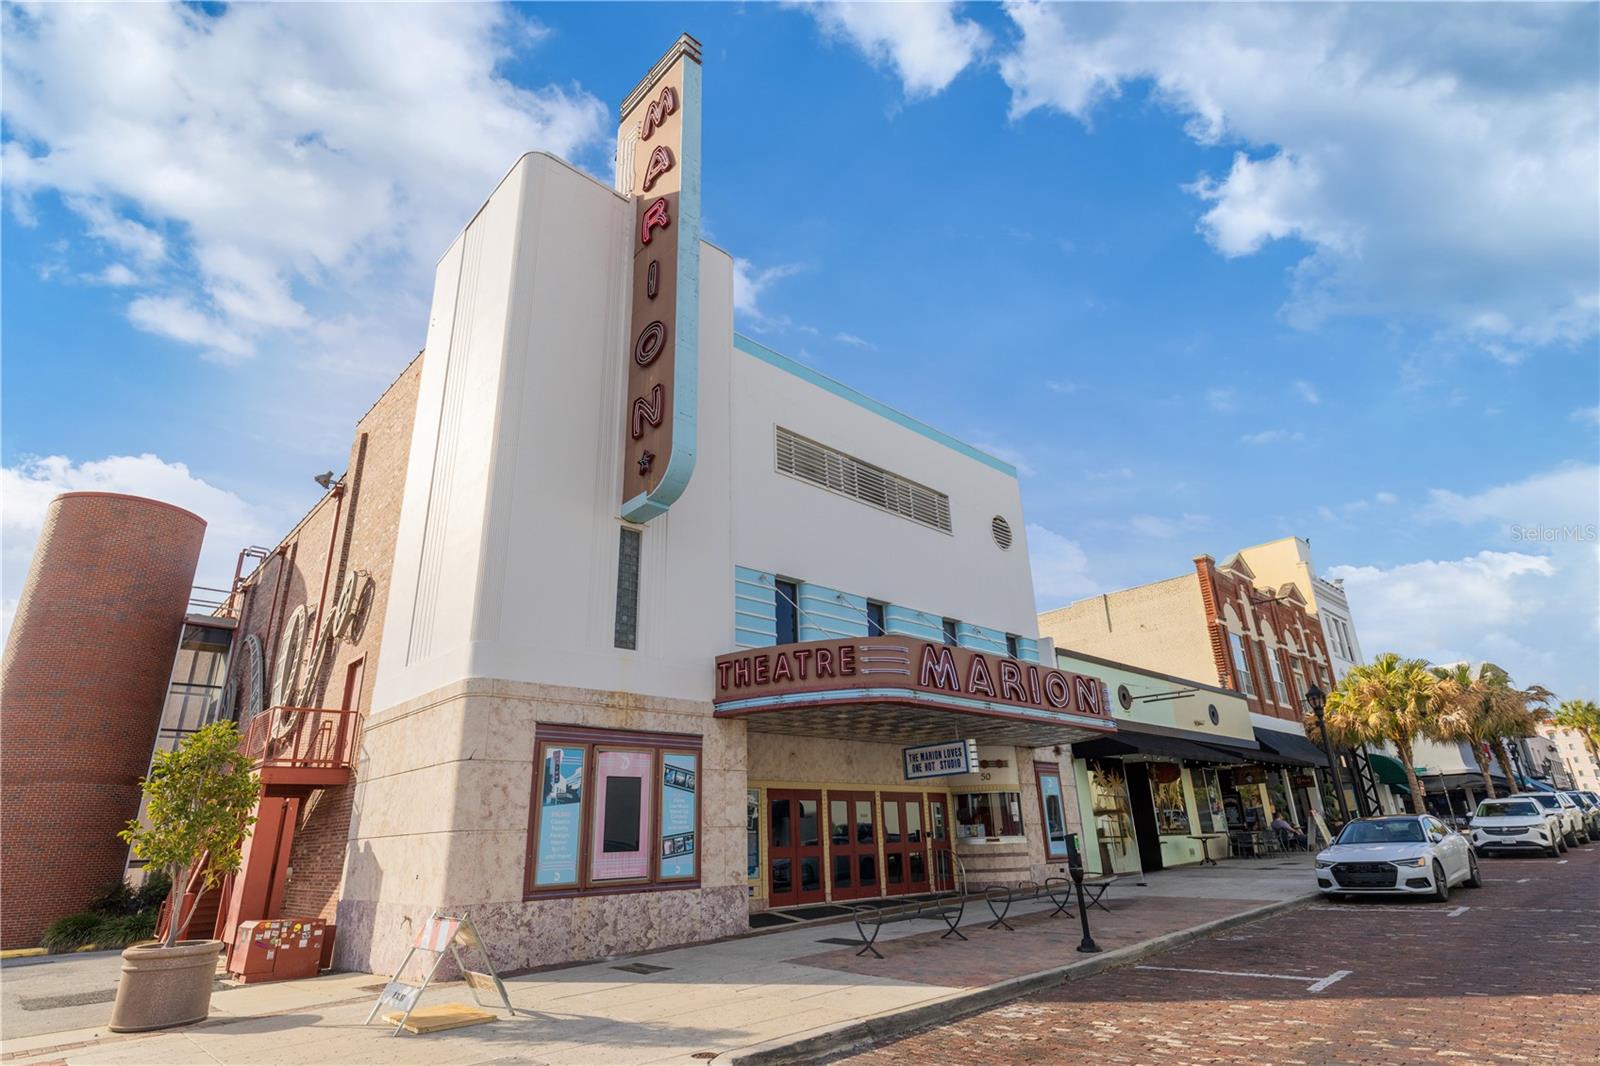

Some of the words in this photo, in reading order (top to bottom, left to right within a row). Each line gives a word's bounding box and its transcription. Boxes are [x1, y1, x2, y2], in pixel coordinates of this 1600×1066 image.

[632, 84, 677, 441] MARION
[717, 645, 857, 691] THEATRE
[919, 643, 1101, 713] MARION
[909, 753, 919, 763] THE
[920, 750, 942, 761] MARION
[943, 747, 962, 758] LOVES
[912, 763, 922, 773] ONE
[940, 758, 961, 770] STUDIO
[980, 772, 992, 781] 50
